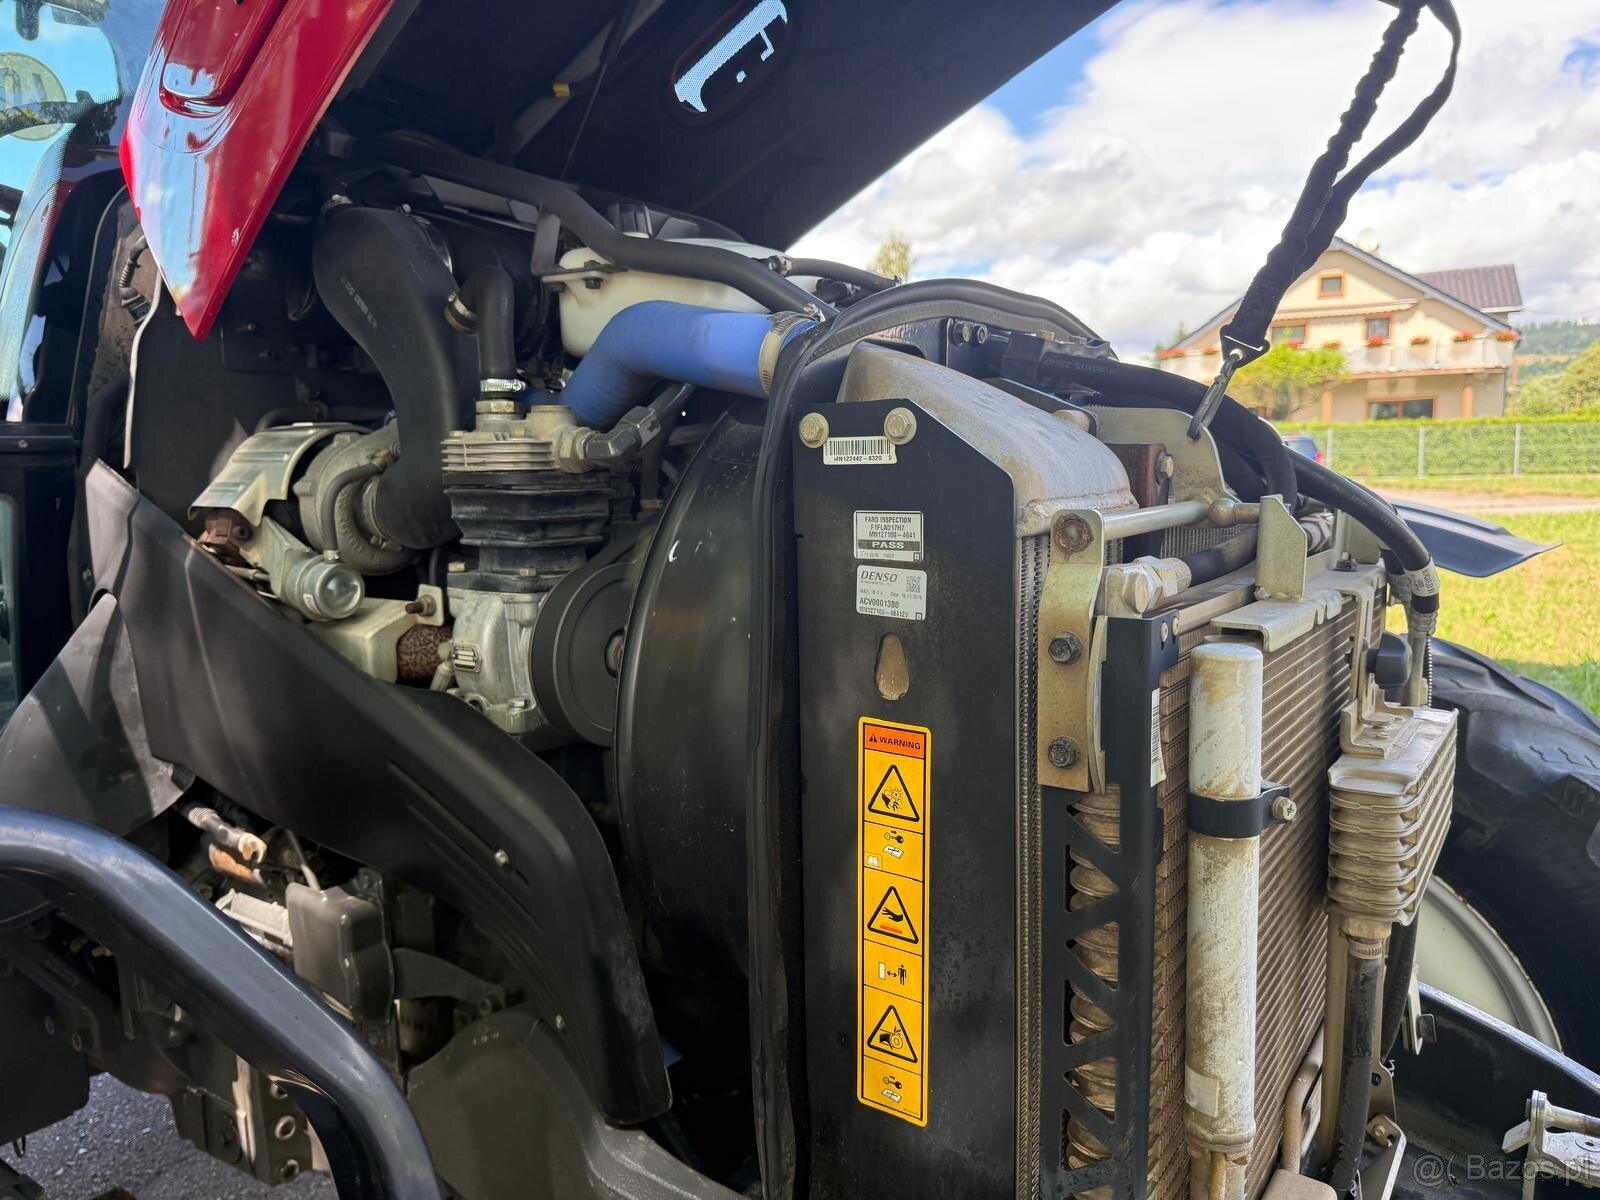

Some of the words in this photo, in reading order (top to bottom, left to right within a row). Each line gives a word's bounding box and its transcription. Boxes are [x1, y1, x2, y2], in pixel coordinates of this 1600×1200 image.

[880, 516, 912, 524] INSPECTION
[871, 541, 905, 549] PASS
[860, 570, 898, 582] DENSO
[879, 736, 921, 750] WARNING
